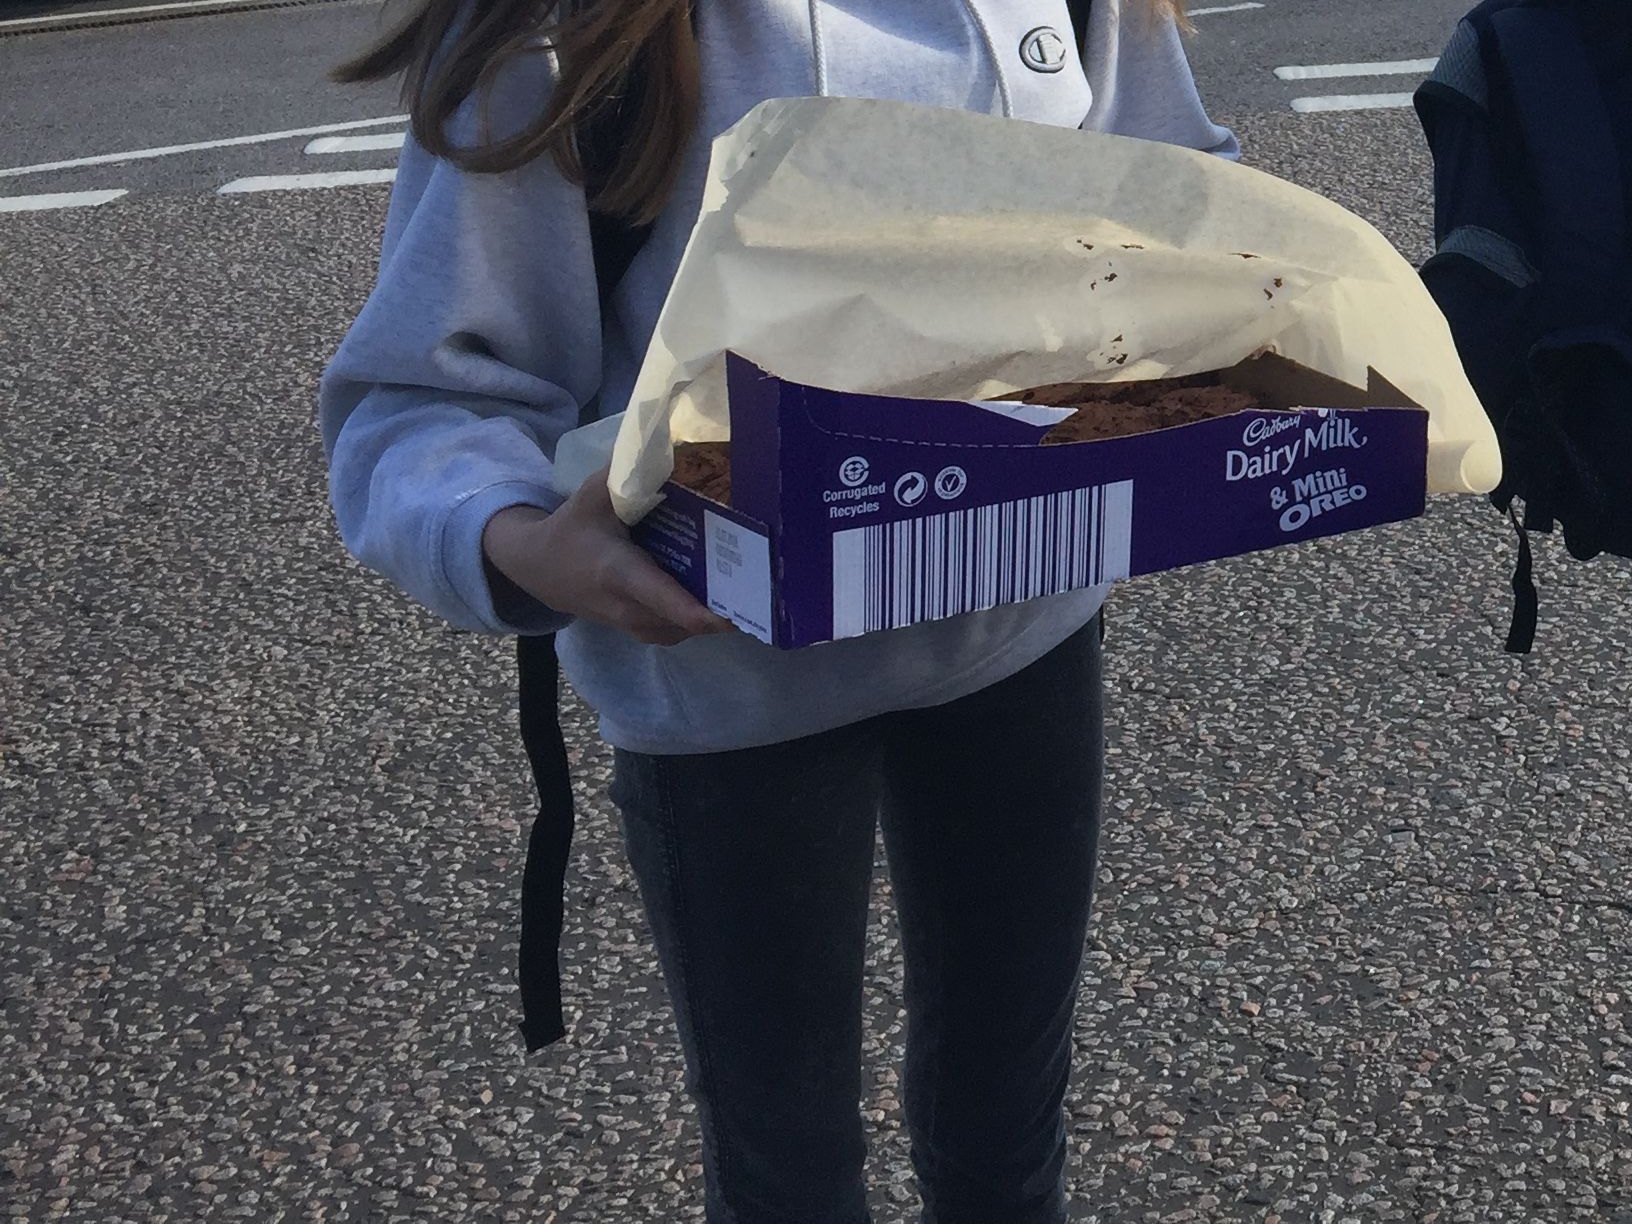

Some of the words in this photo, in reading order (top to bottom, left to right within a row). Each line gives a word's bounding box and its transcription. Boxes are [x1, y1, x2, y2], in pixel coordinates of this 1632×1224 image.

[1243, 414, 1301, 447] Cadbury
[1225, 439, 1301, 481] Dairy
[1304, 418, 1368, 458] Milk
[823, 482, 887, 503] Corrugated
[1270, 486, 1289, 510] &
[1291, 468, 1348, 503] Mini
[829, 501, 880, 519] Recycles
[1279, 484, 1368, 532] OREO
